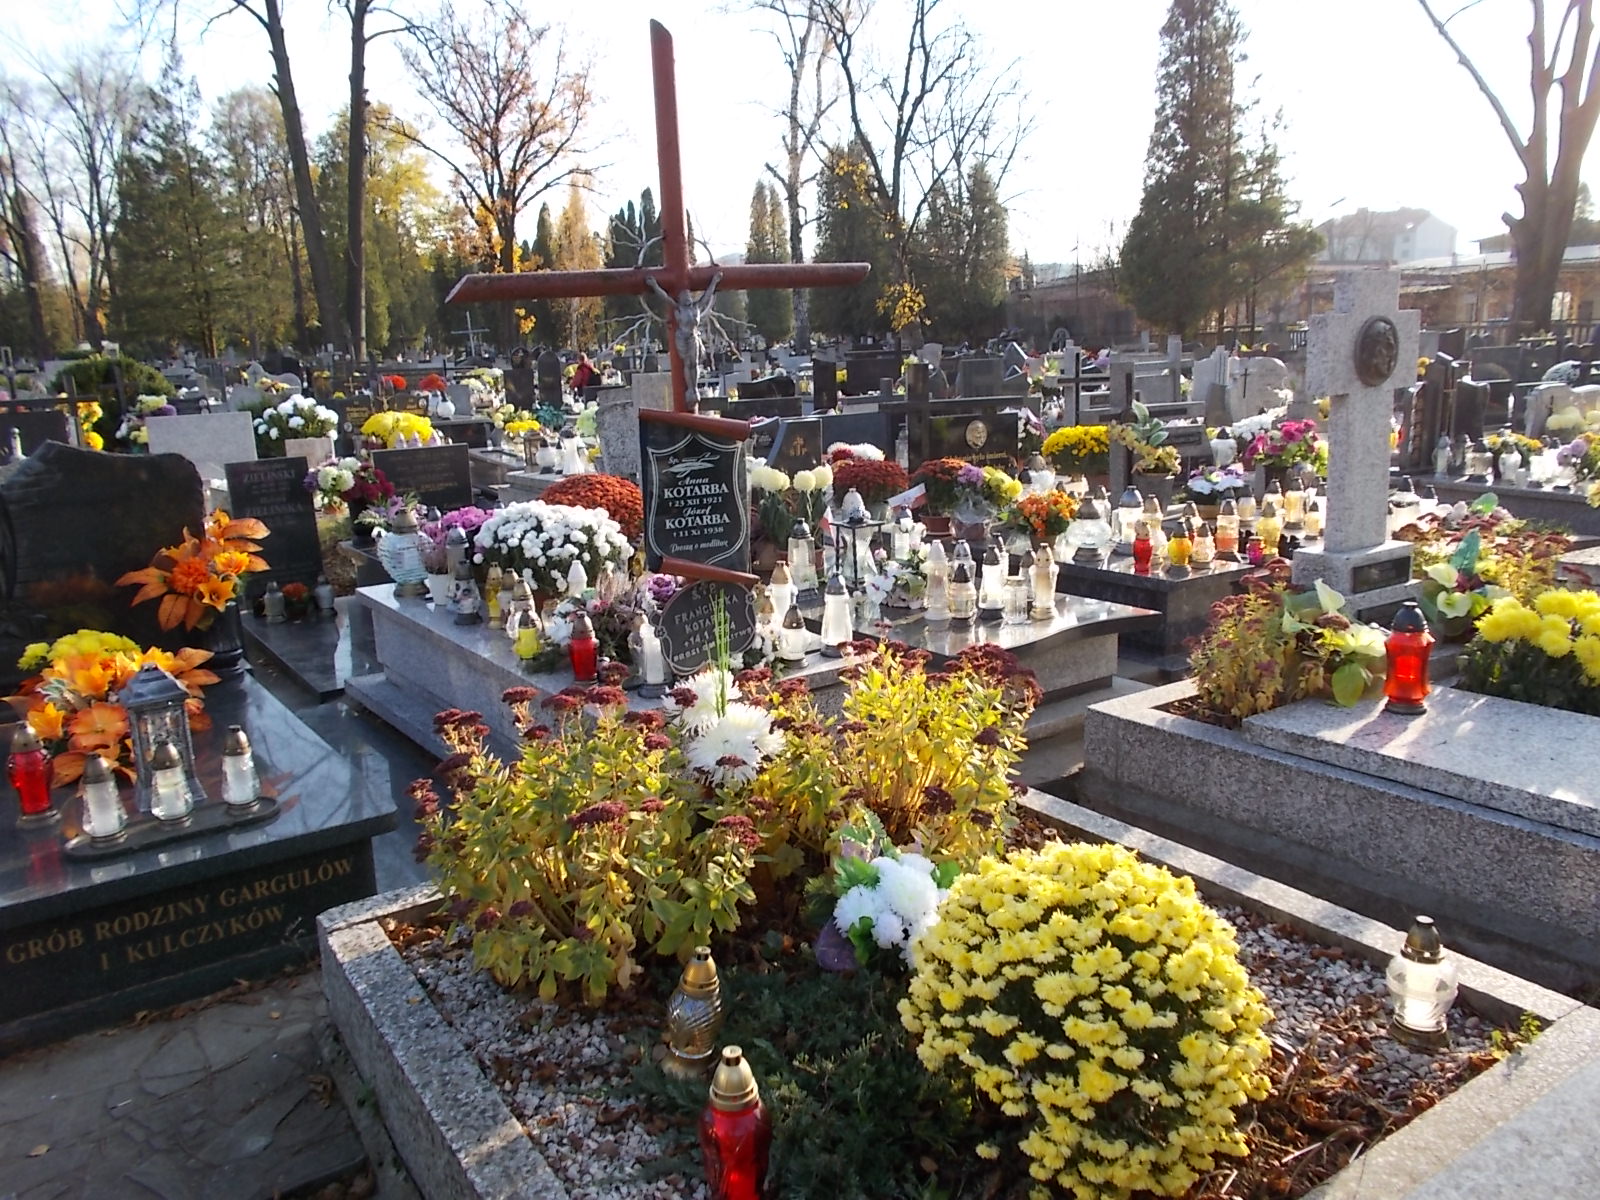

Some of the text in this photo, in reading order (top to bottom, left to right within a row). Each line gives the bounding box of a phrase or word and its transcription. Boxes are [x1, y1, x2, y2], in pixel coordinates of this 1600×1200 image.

[678, 476, 710, 485] Anna
[664, 482, 729, 499] KOTARBA
[687, 497, 700, 506] XII
[703, 496, 723, 504] 1921
[683, 505, 712, 516] Józef
[665, 513, 730, 529] KOTARBA
[679, 530, 689, 538] 11
[703, 526, 725, 535] 1938
[674, 594, 738, 625] FRANCIKA
[5, 857, 354, 965] GRÓB RODZINY GARGULÓW
[98, 904, 287, 971] I KULCZYKÓW
